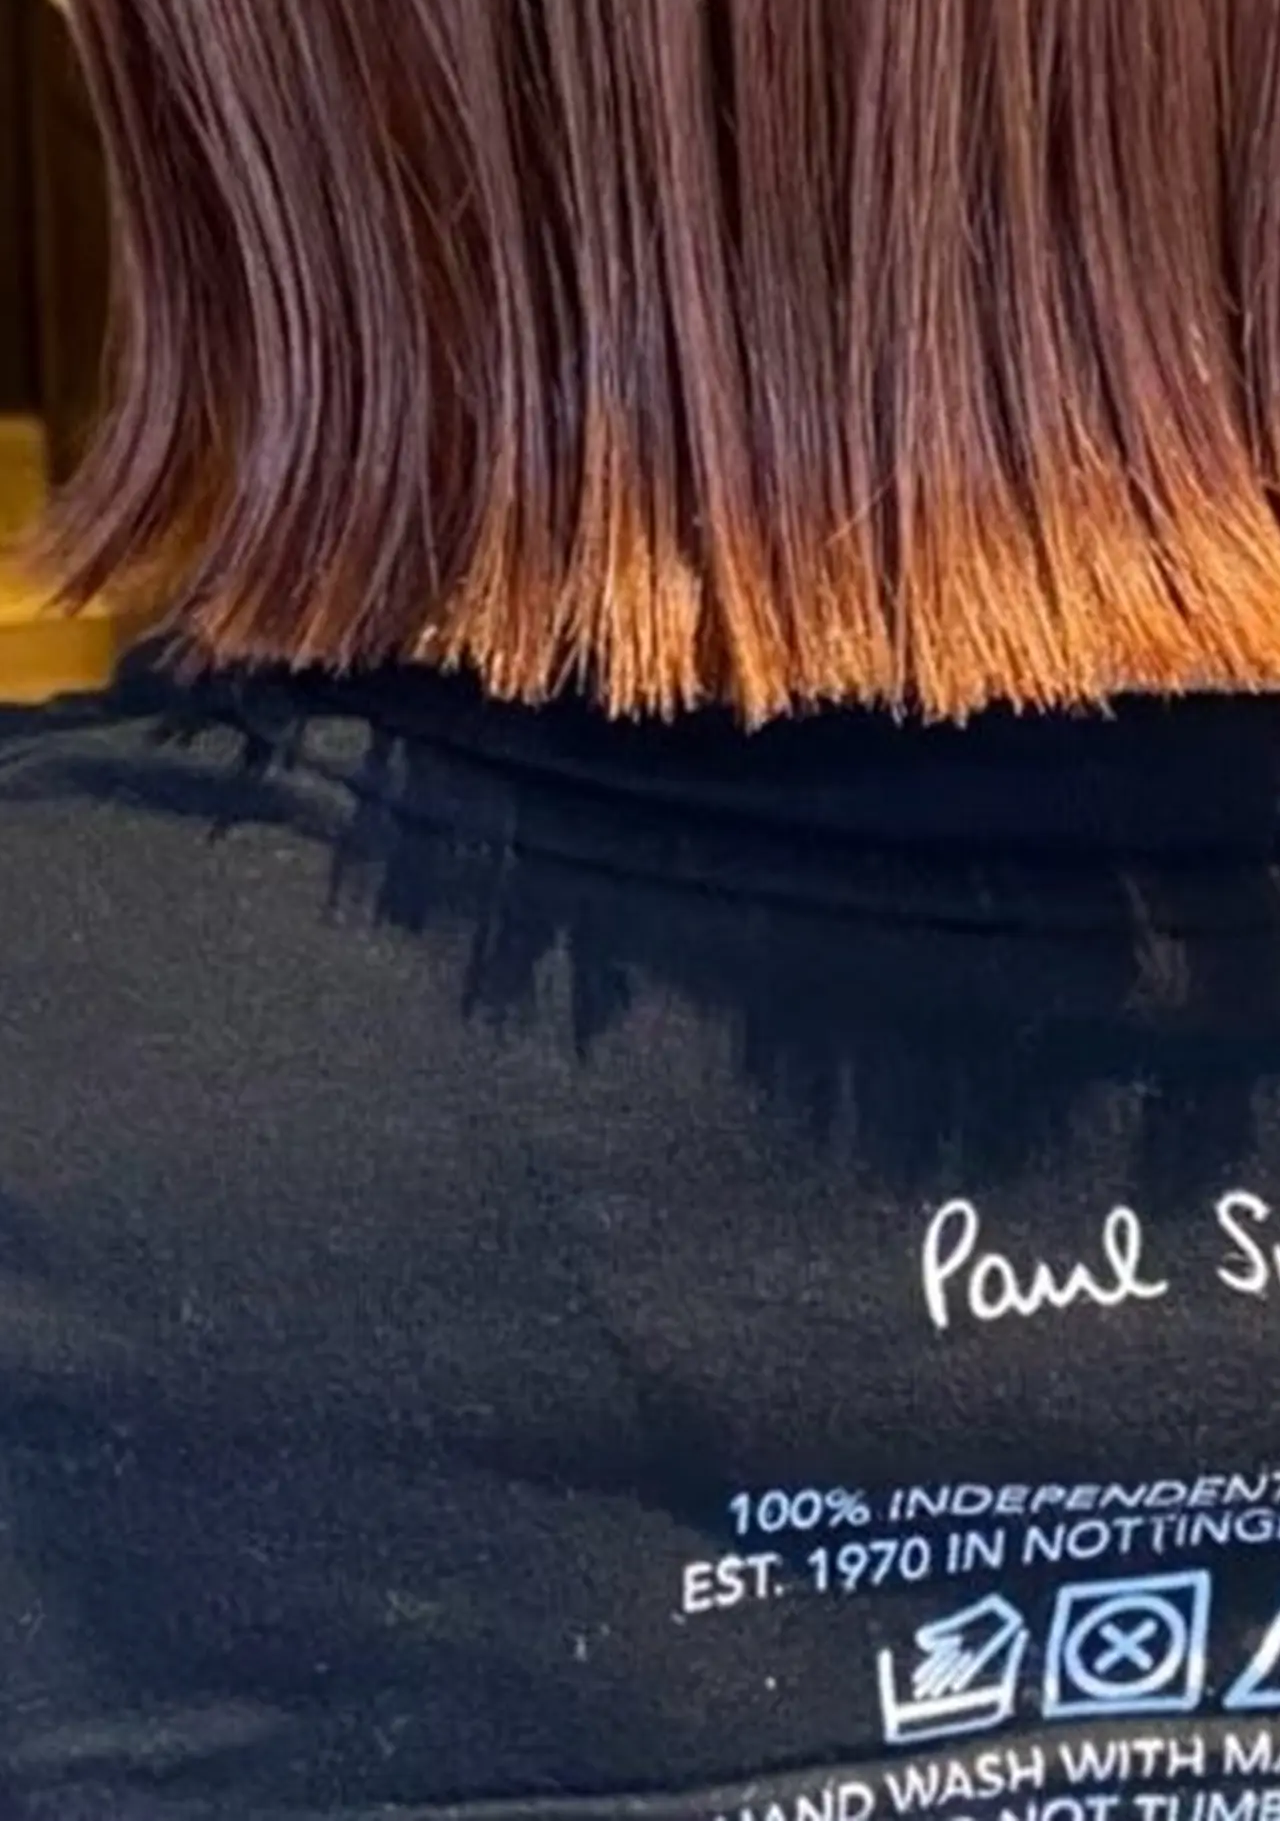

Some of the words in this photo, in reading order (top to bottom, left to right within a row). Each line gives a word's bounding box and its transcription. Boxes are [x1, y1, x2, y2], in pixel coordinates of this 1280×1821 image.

[923, 1199, 1168, 1328] Paul
[730, 1488, 871, 1534] 100%
[682, 1553, 785, 1613] EST.
[808, 1536, 929, 1592] 1970
[946, 1530, 1005, 1574] IN
[884, 1744, 1045, 1813] WASH
[1060, 1735, 1204, 1783] WITH
